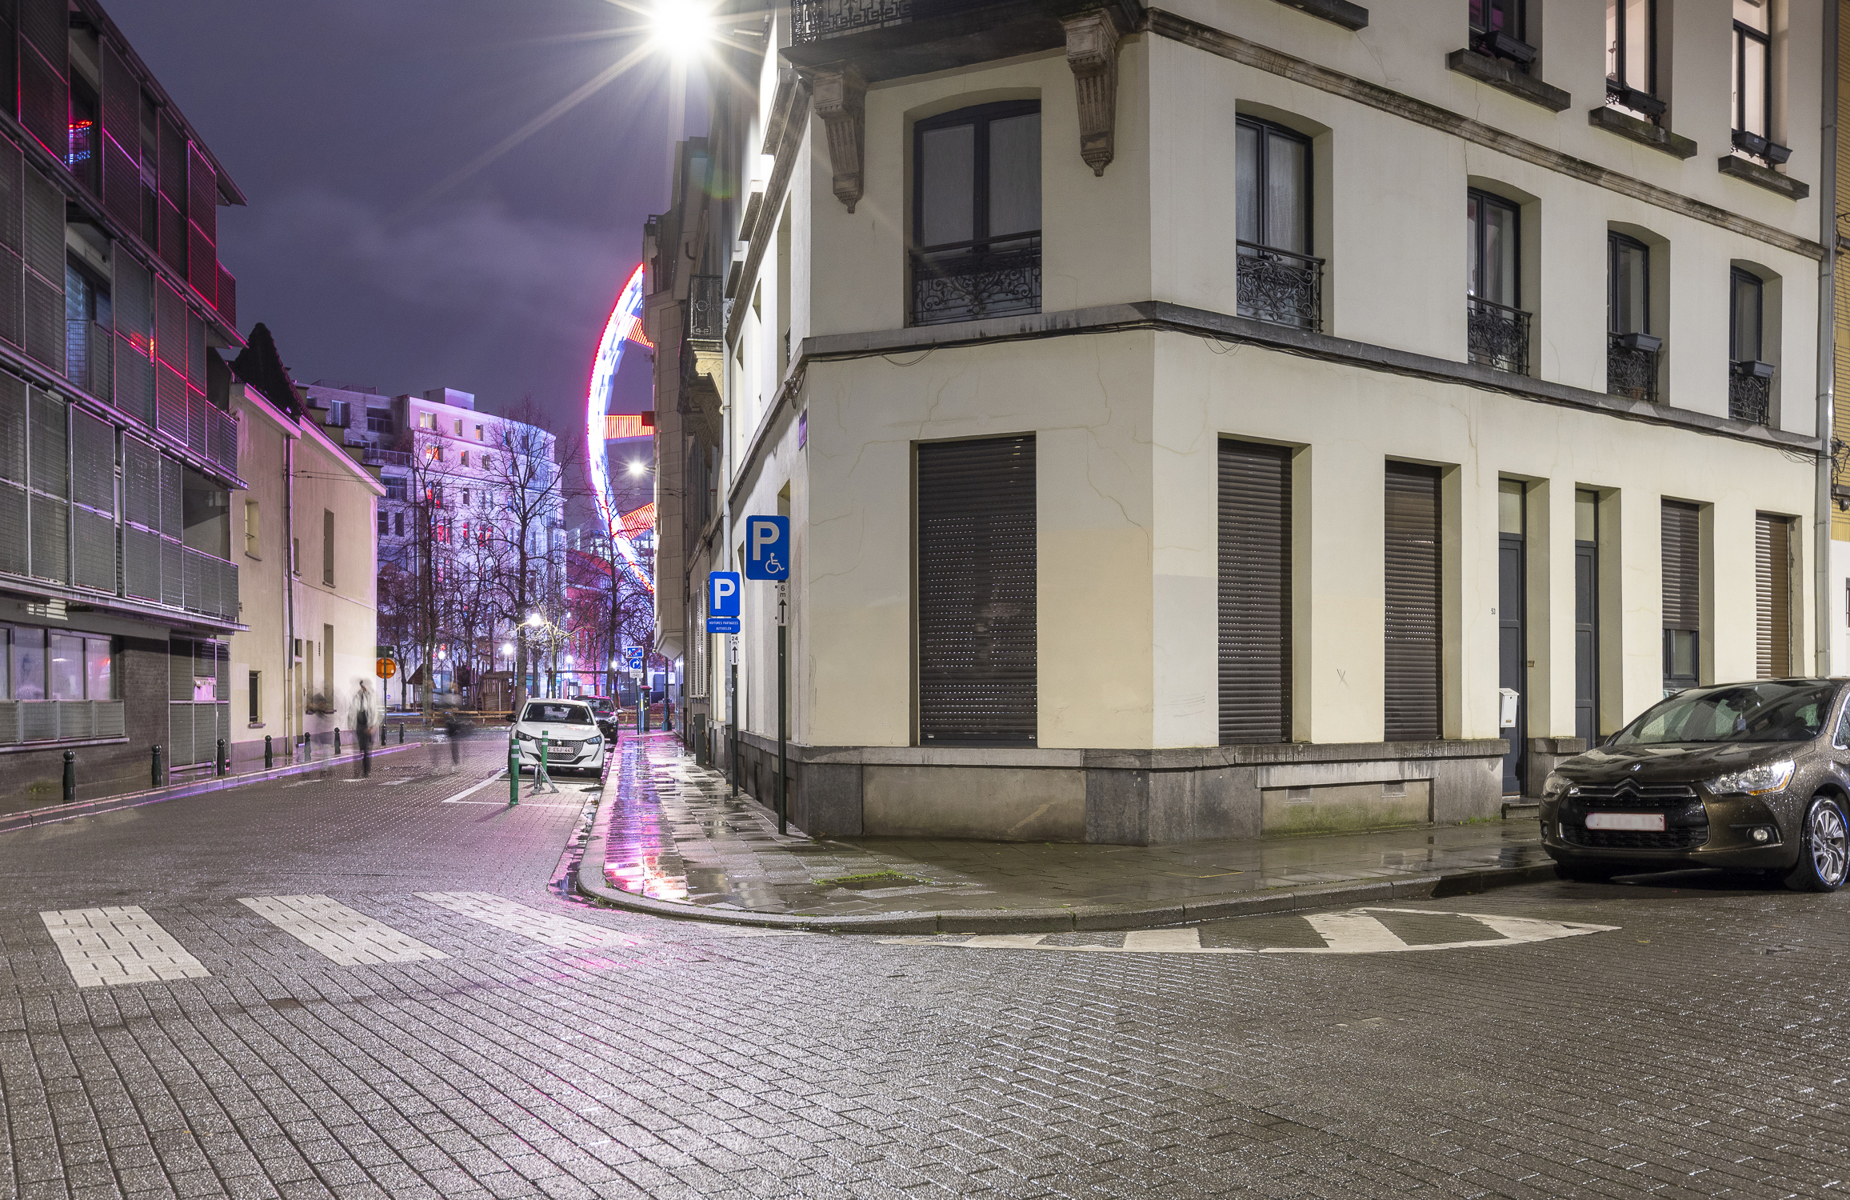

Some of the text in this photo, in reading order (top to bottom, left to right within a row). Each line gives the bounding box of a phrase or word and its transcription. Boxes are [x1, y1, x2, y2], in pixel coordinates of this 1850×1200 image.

[752, 521, 780, 561] P
[714, 578, 736, 610] P
[780, 584, 786, 592] 6
